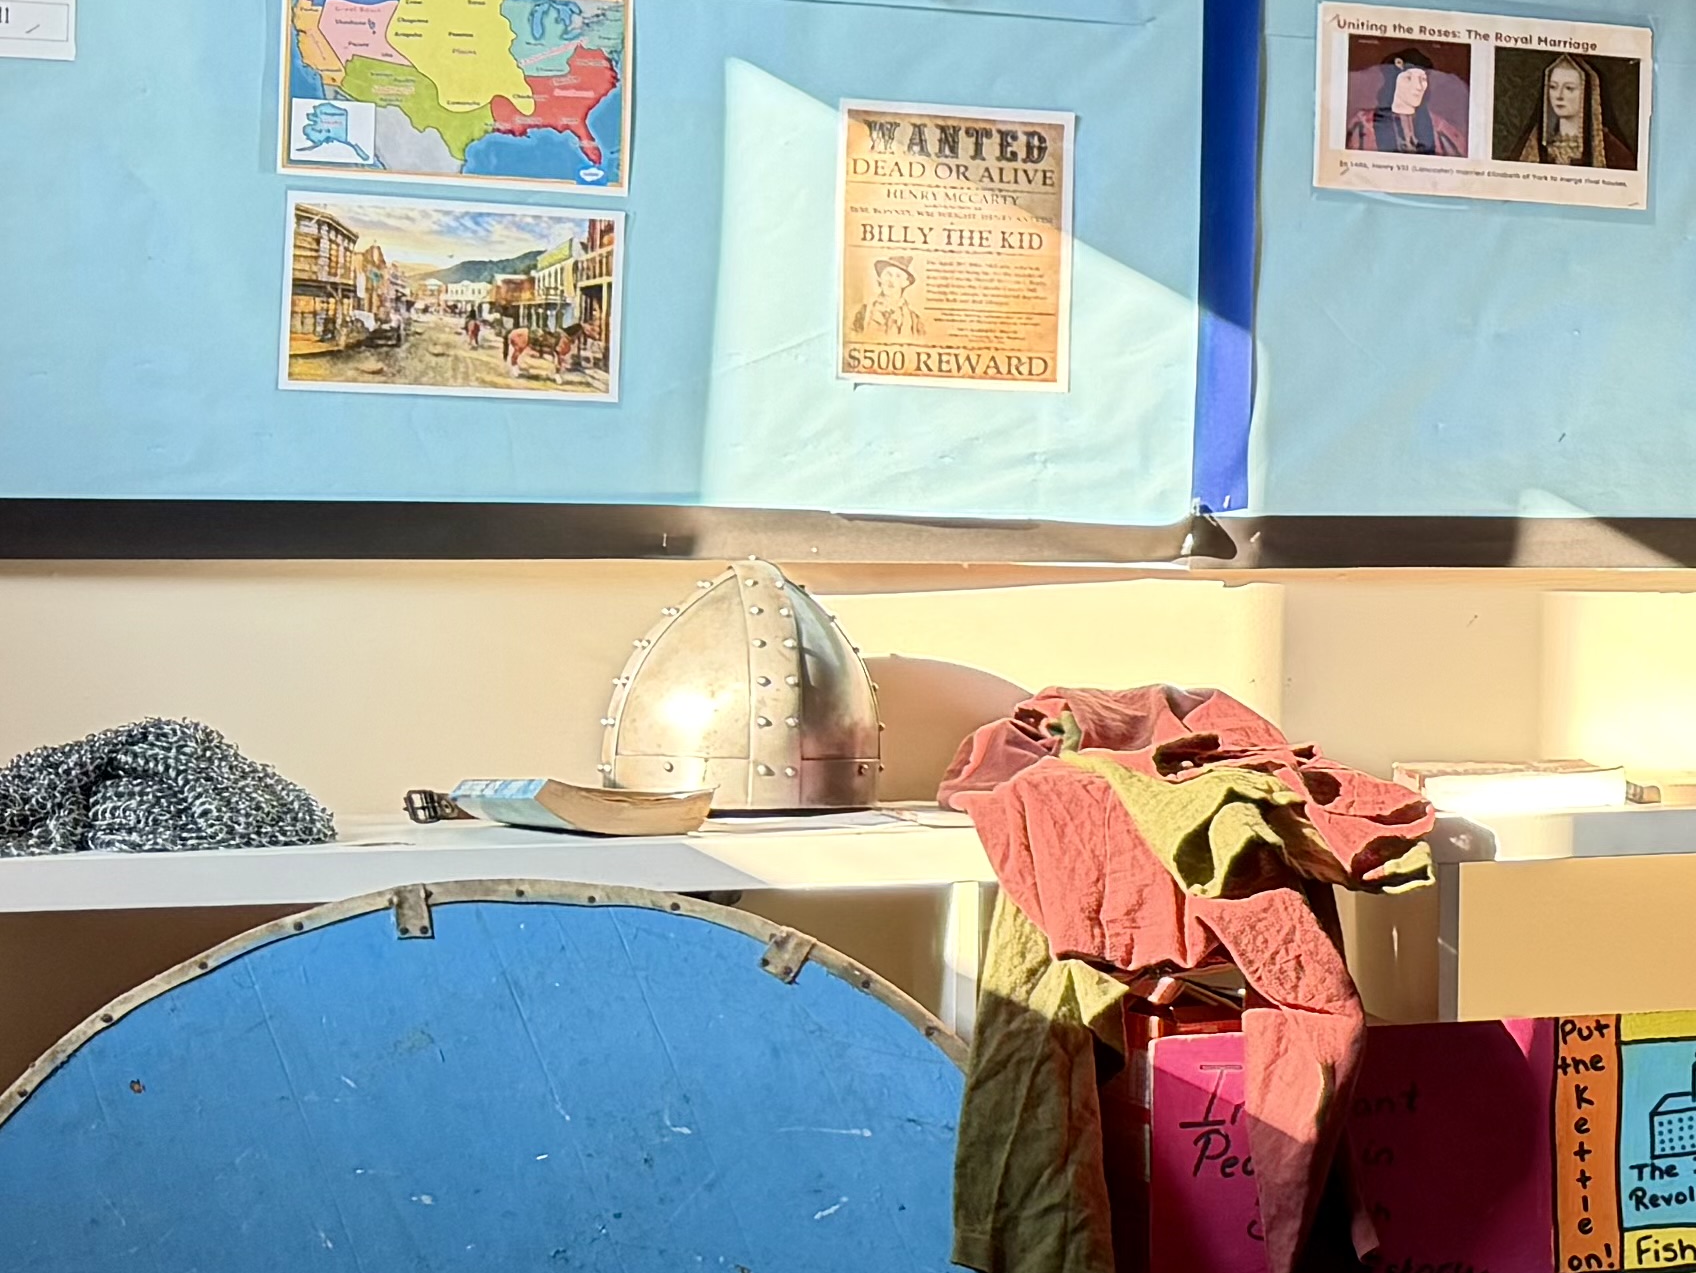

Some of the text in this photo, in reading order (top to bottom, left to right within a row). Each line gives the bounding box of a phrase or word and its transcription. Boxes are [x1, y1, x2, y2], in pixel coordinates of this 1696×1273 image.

[1336, 18, 1598, 52] Uniting the Roses: The Royal Marriage
[864, 119, 1048, 165] WANTED
[852, 157, 1055, 187] DEAD OR ALIVE
[861, 223, 1044, 250] BILLY THE KID
[847, 347, 1048, 377] $500 REWARD
[1629, 1162, 1680, 1183] The
